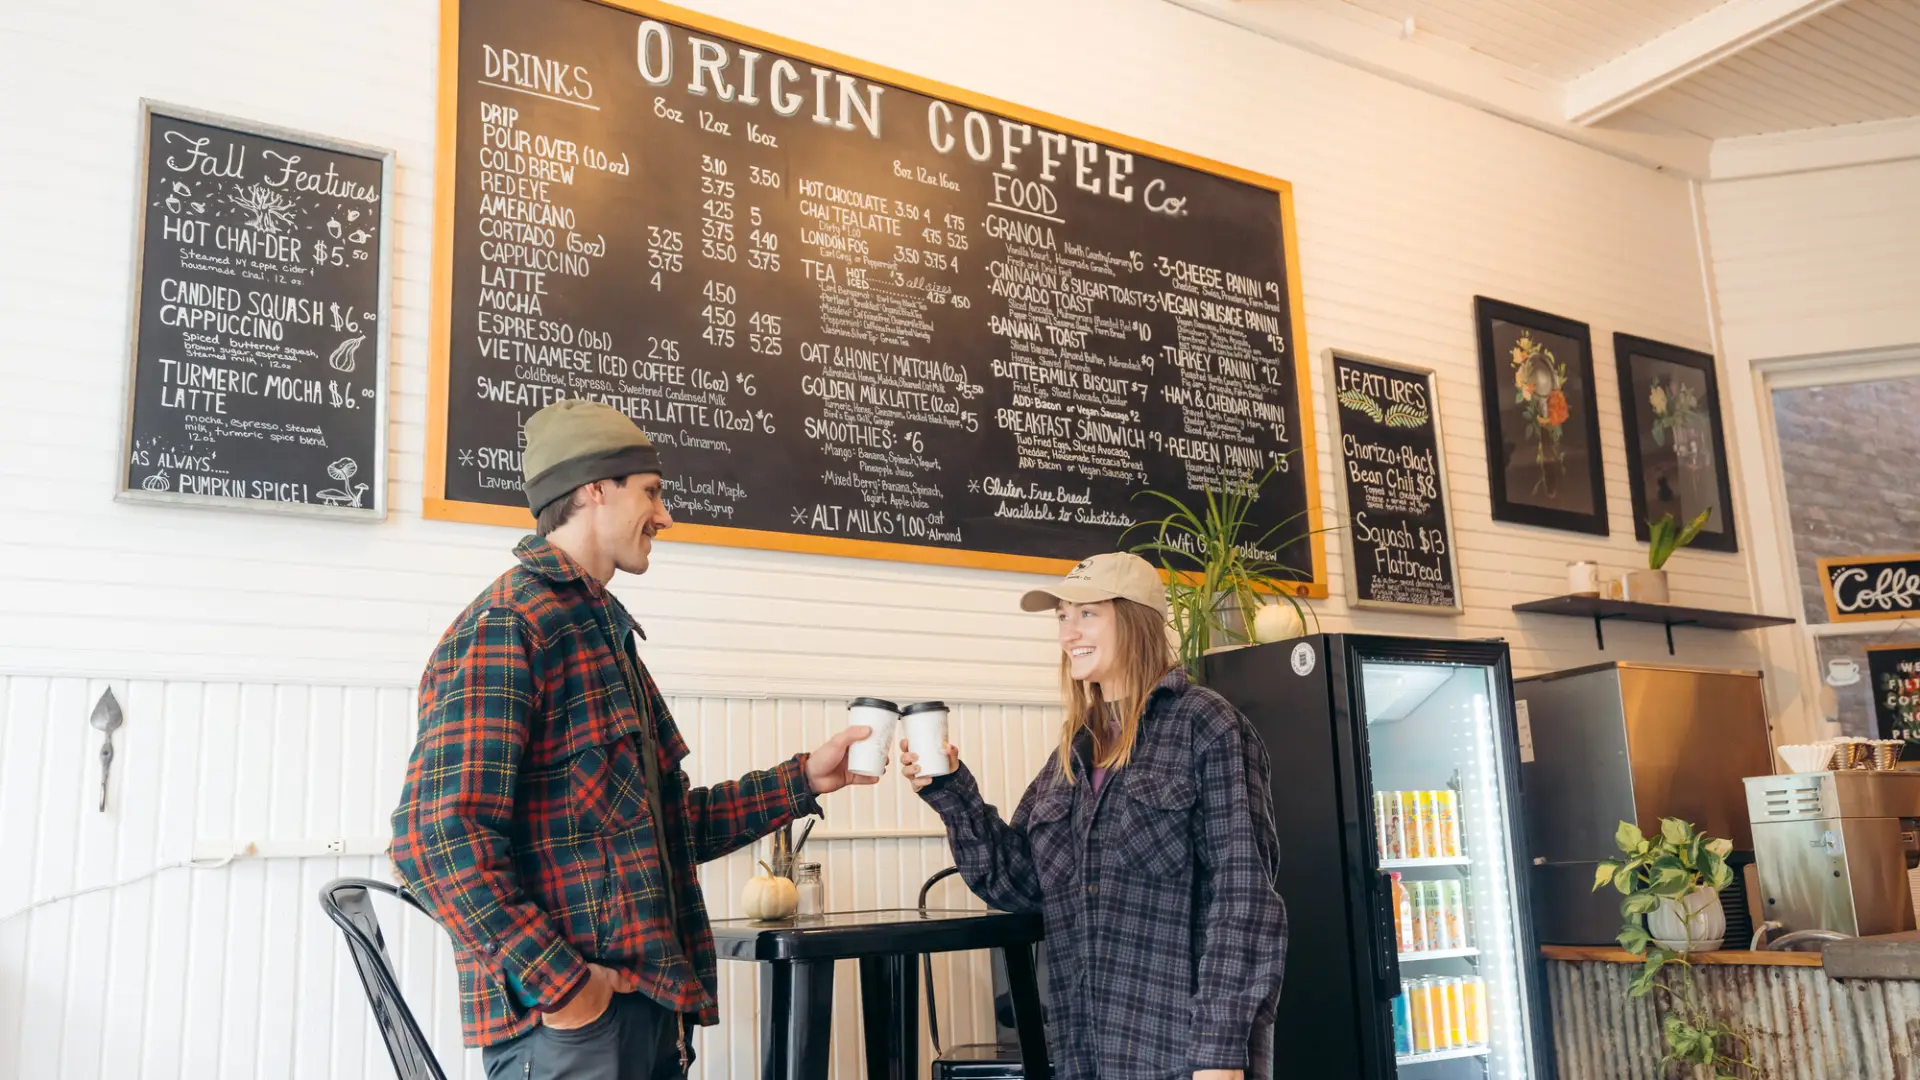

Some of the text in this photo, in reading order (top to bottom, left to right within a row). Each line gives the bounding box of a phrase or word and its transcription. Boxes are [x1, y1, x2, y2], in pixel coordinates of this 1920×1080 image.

[483, 44, 593, 101] DRINKS
[637, 20, 885, 139] ORIGIN
[928, 100, 1134, 203] COFFEE
[653, 97, 778, 148] 8oz 12oz 16oz
[481, 101, 780, 188] DRIP 3.10 3.50
[483, 123, 735, 199] POUR OVER 3.75
[164, 131, 379, 203] Fall Features
[917, 166, 961, 192] 12oz 16oz
[480, 147, 762, 226] COLD BREW 5
[799, 178, 919, 220] HOT CHOCOLATE 3.50
[992, 172, 1058, 215] FOOD
[481, 171, 778, 251] RED EYE 3.75 4.40
[799, 200, 902, 236] CHAI LATTE
[164, 215, 210, 247] HOT
[215, 225, 301, 263] CHAI-DER
[480, 193, 780, 272] AMERICANO 3.25 3.50 3.75
[480, 218, 683, 273] CORTADO 3.75
[800, 227, 920, 264] LONDON FOG 3.50
[985, 213, 1057, 251] GRANOLA
[180, 247, 231, 265] Steamed
[181, 259, 236, 276] housemade
[480, 240, 589, 278] CAPPUCCINO
[481, 265, 548, 295] LATTE
[800, 258, 925, 291] TEA HOT all
[847, 278, 870, 290] ICED
[990, 260, 1143, 308] CINNAMON SUGAR TOAST
[1158, 256, 1263, 299] 3-CHEESE PANINI
[161, 278, 324, 326] CANDIED SQUASH
[478, 287, 542, 317] MOCHA
[992, 279, 1094, 314] AVOCADO TOAST
[1158, 291, 1279, 336] VEGAN SAUSAGE PANINI
[160, 304, 284, 341] CAPPUCCINO
[478, 311, 574, 345] ESPRESSO
[991, 315, 1088, 350] BANANA TOAST
[183, 331, 281, 353] Spiced butternut
[184, 341, 216, 354] brown
[477, 336, 686, 386] VIETNAMESE ICED COFFEE
[800, 341, 830, 365] OAT
[845, 346, 890, 374] HONEY
[893, 354, 943, 382] MATCHA
[942, 361, 968, 385] (12oz)
[1162, 345, 1257, 382] TURKEY PANINI
[158, 358, 323, 405] TURMERIC MOCHA
[665, 387, 727, 406] Condensed Milk
[801, 374, 960, 416] GOLDEN MILK LATTE (12oz)
[993, 359, 1148, 402] BUTTERMILK BISCUIT $7
[1339, 366, 1426, 409] FEATURES
[161, 386, 227, 414] LATTE
[656, 399, 710, 427] LATTE
[713, 408, 754, 432] (12oz)
[1035, 397, 1100, 420] Bacon Vegan
[1165, 385, 1285, 424] HAM CHEDDAR PANINI
[215, 428, 295, 443] turmeric spice
[680, 430, 732, 454] Cinnamon,
[804, 416, 898, 450] SMOOTHIES:
[997, 408, 1146, 450] BREAKFAST SANDWICH
[1014, 432, 1097, 454] Two Fried Sliced
[131, 450, 149, 467] AS
[859, 460, 914, 479] Pineapple Juice
[1052, 449, 1144, 471] Housemade Bread
[1168, 436, 1264, 470] REUBEN PANINI
[179, 474, 309, 504] PUMPKIN SPICE!
[689, 477, 714, 495] Local
[824, 470, 852, 487] Mixed
[1078, 465, 1102, 480] Vegan
[1349, 461, 1437, 500] Bean Chili $8
[674, 495, 703, 516] Simple
[704, 500, 734, 519] Syrup
[890, 494, 930, 510] Apple Juice
[983, 476, 1092, 505] Gluten Free Bread
[811, 503, 895, 535] ALT MILKS
[994, 500, 1137, 528] Available to Substitute
[1356, 511, 1414, 550] Squash
[928, 526, 962, 543] Almond
[1165, 532, 1194, 554] Wifi
[1375, 547, 1442, 582] Flatbread
